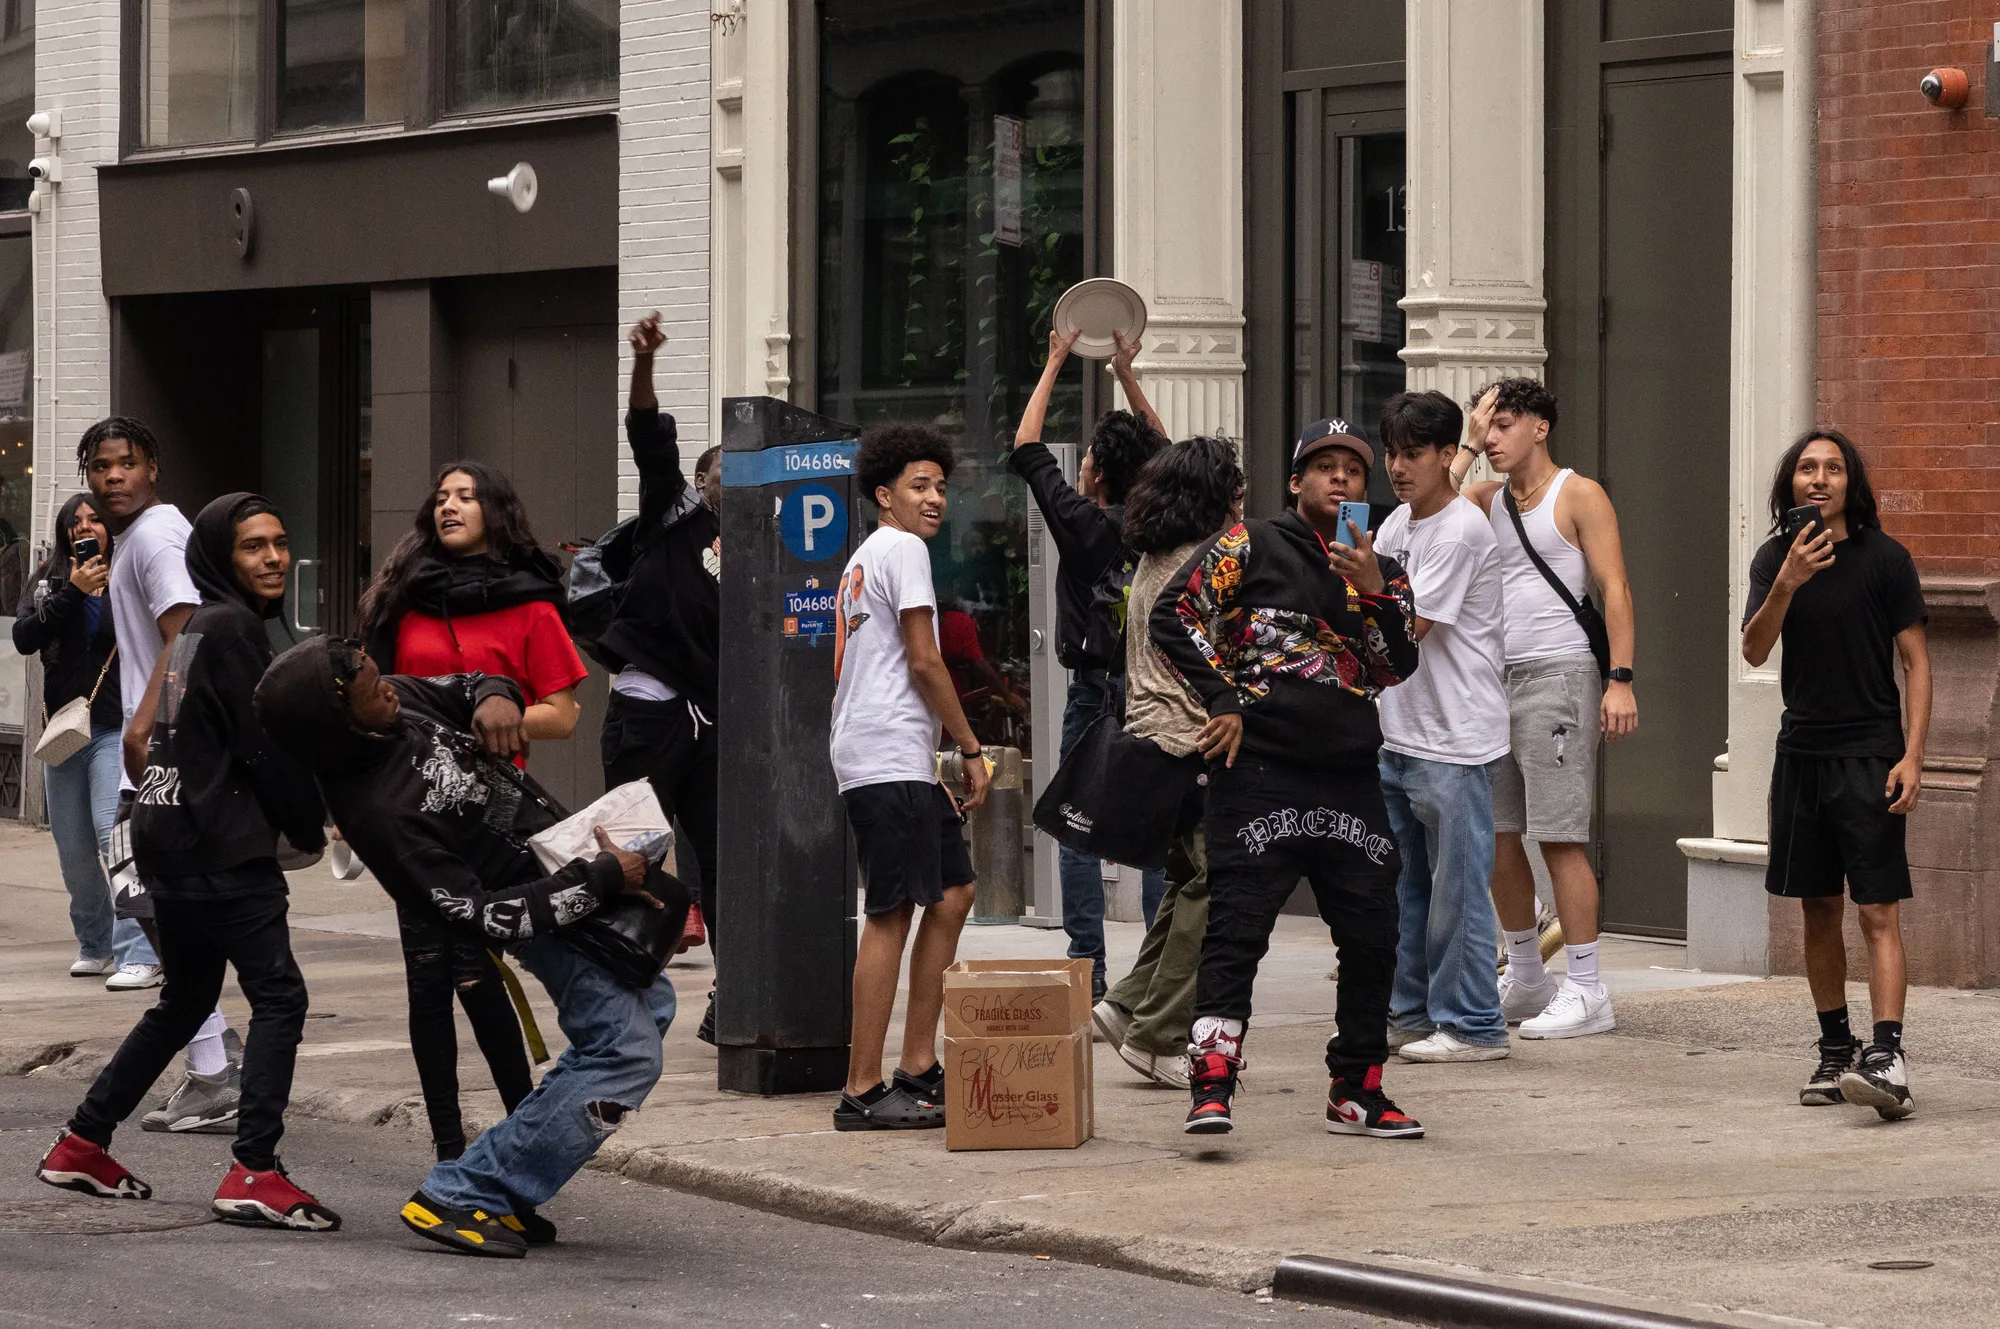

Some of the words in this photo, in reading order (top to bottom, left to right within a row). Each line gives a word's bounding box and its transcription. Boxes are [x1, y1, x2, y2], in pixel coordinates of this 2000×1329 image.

[1328, 419, 1349, 435] NY
[785, 453, 842, 471] 104680
[802, 494, 835, 551] P
[789, 595, 836, 613] 104680
[975, 1007, 1011, 1021] FRAGILE
[1013, 1007, 1042, 1021] GLASS
[1025, 1090, 1059, 1102] Glass
